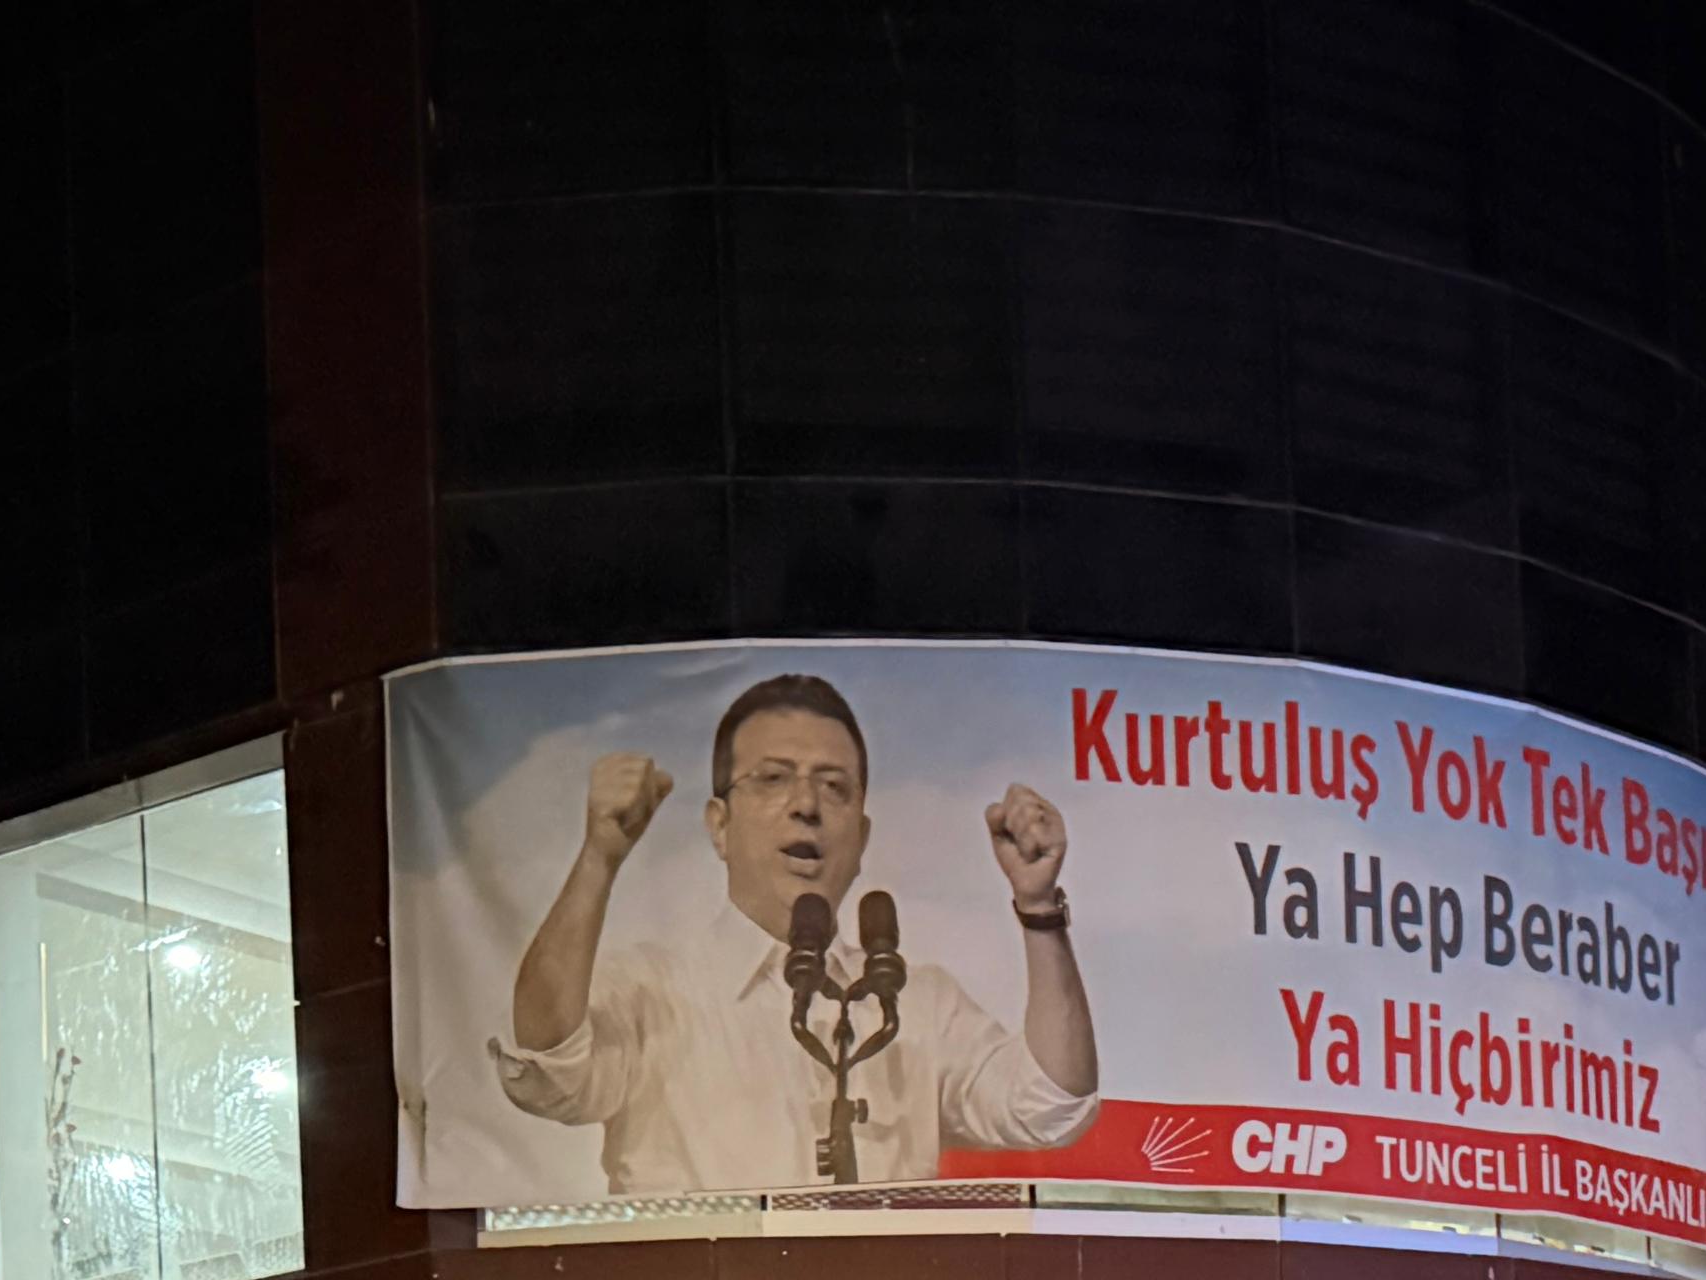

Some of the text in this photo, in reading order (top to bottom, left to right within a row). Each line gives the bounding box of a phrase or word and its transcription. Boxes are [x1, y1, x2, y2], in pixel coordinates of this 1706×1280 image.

[1073, 688, 1379, 818] Kurtuluş
[1396, 721, 1506, 828] Yok
[1522, 747, 1609, 855] Tek
[1235, 842, 1680, 1006] Ya Hep Beraber
[1280, 989, 1661, 1133] Ya Hiçbirimiz
[1231, 1120, 1346, 1178] CHP
[1376, 1134, 1529, 1195] TUNCELİ
[1540, 1142, 1569, 1199] İL
